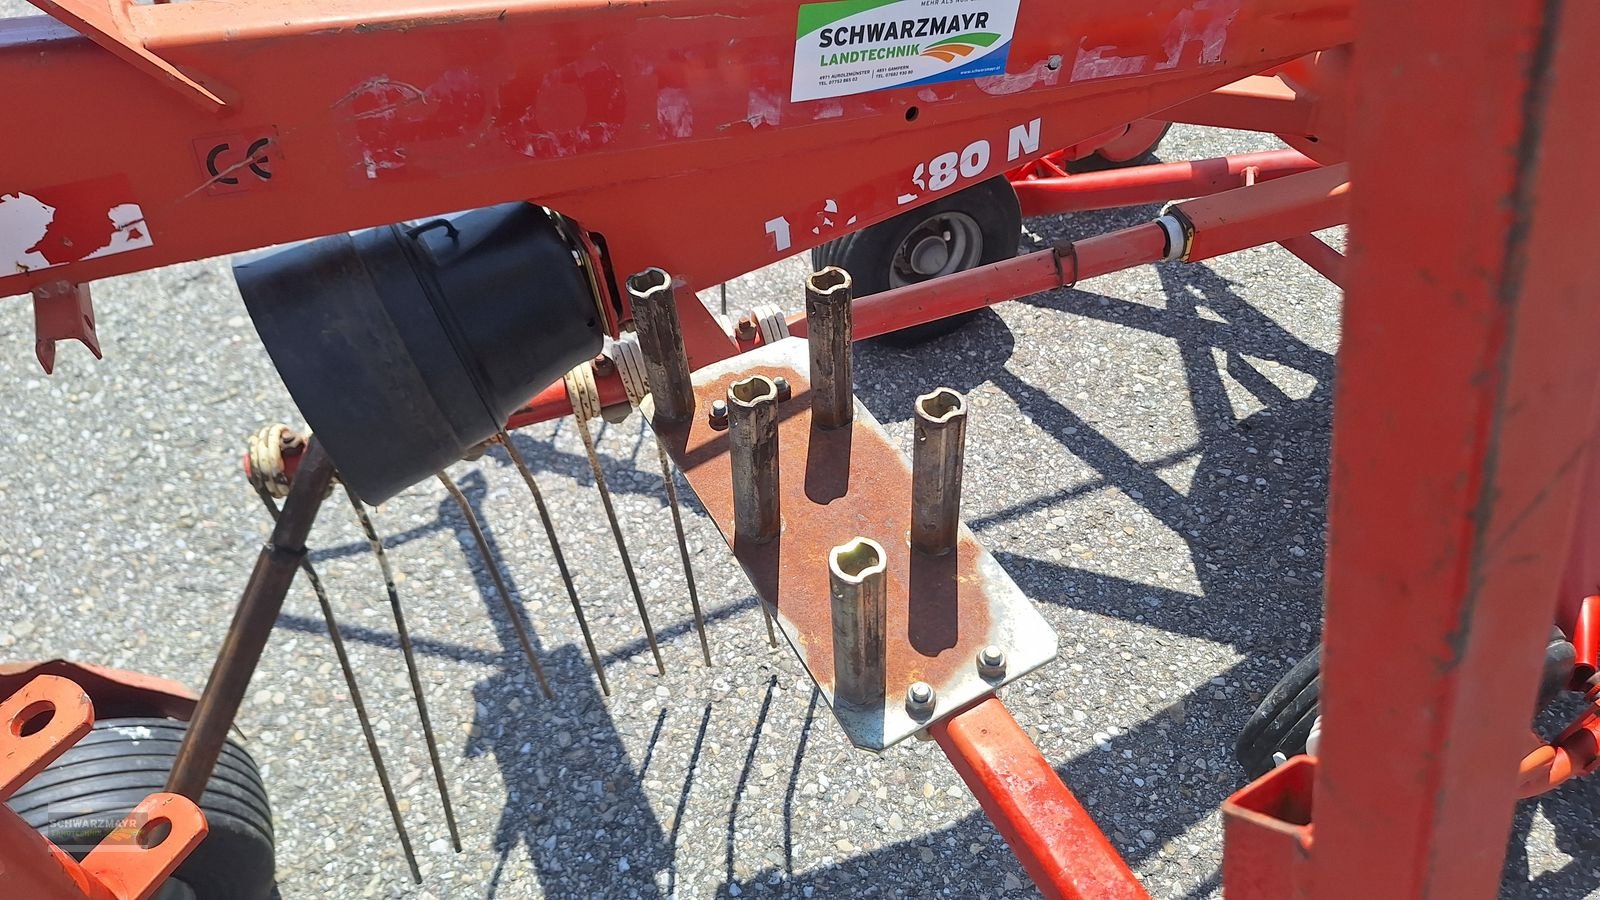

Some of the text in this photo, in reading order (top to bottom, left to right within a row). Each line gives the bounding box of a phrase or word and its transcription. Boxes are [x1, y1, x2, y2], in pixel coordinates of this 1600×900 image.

[818, 11, 989, 48] SCHWARZMAYR
[820, 43, 920, 67] LANDTECHNIK
[1007, 117, 1042, 162] N
